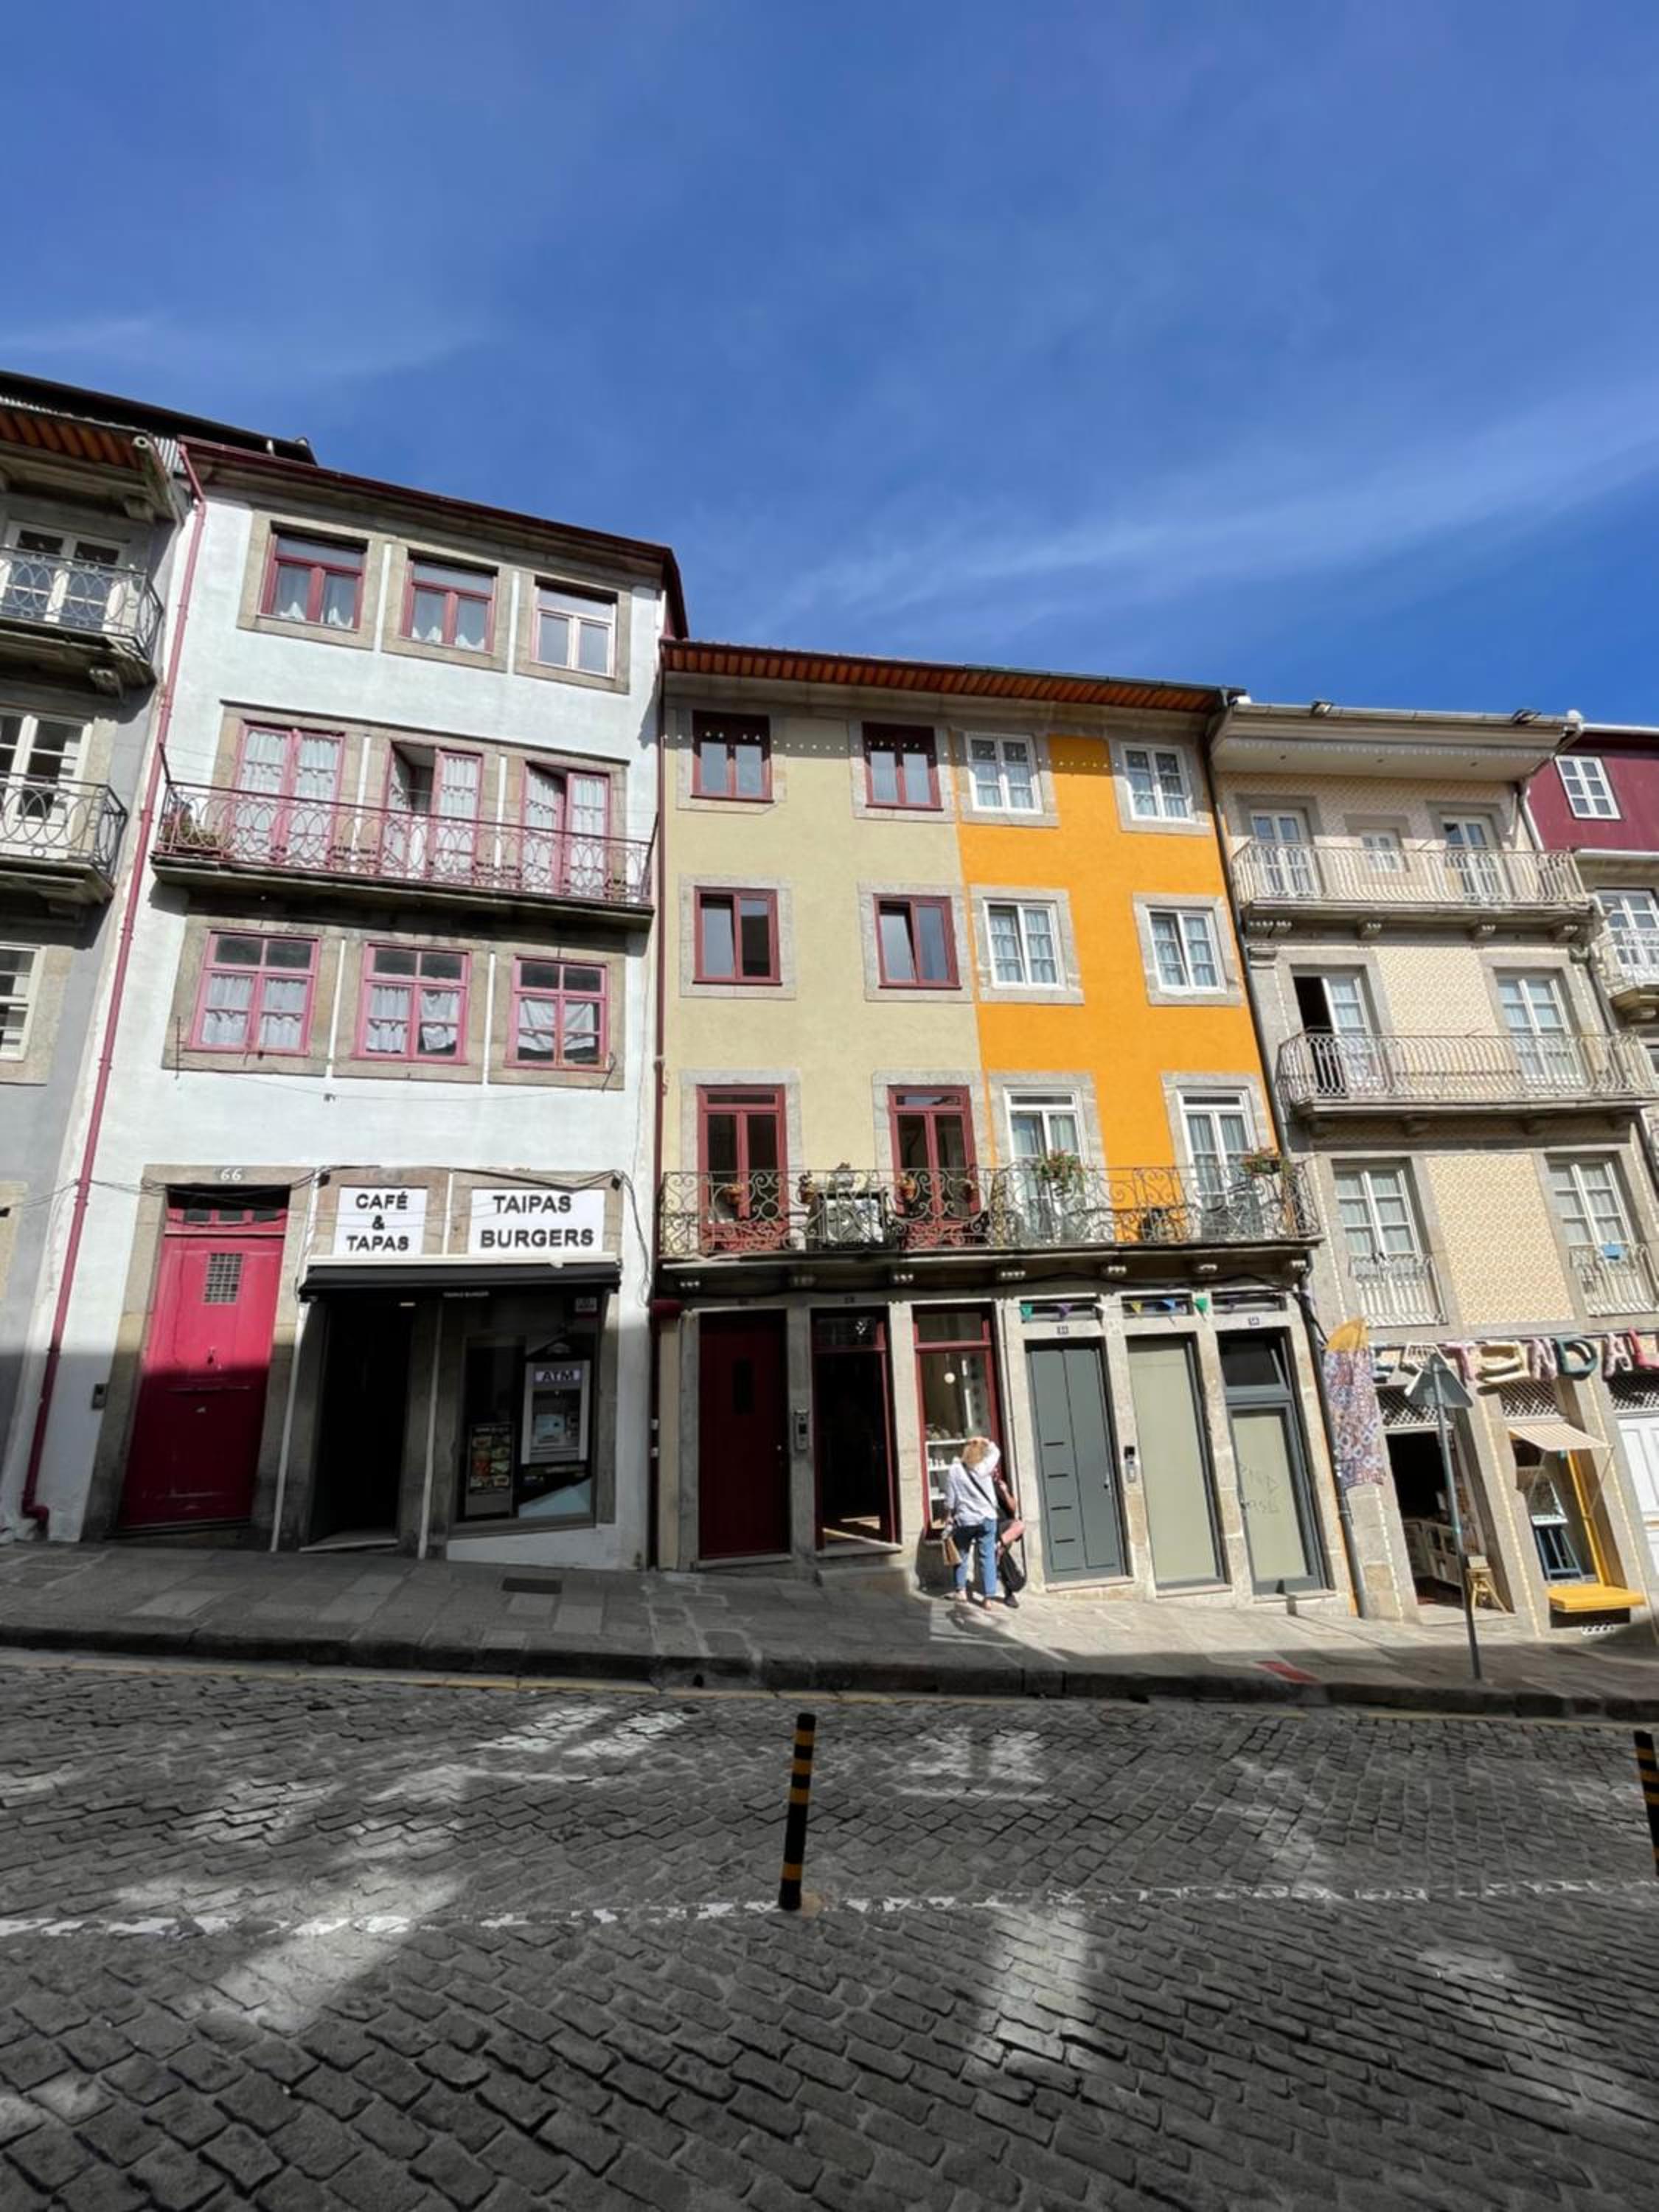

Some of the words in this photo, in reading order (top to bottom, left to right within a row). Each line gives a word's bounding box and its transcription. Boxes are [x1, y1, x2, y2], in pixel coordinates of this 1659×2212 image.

[220, 1168, 243, 1180] 66
[355, 1191, 408, 1210] CAFÉ
[493, 1194, 571, 1214] TAIPAS
[372, 1215, 385, 1231] &
[347, 1235, 409, 1251] TAPAS
[481, 1228, 594, 1248] BURGERS
[542, 1370, 574, 1382] ATM
